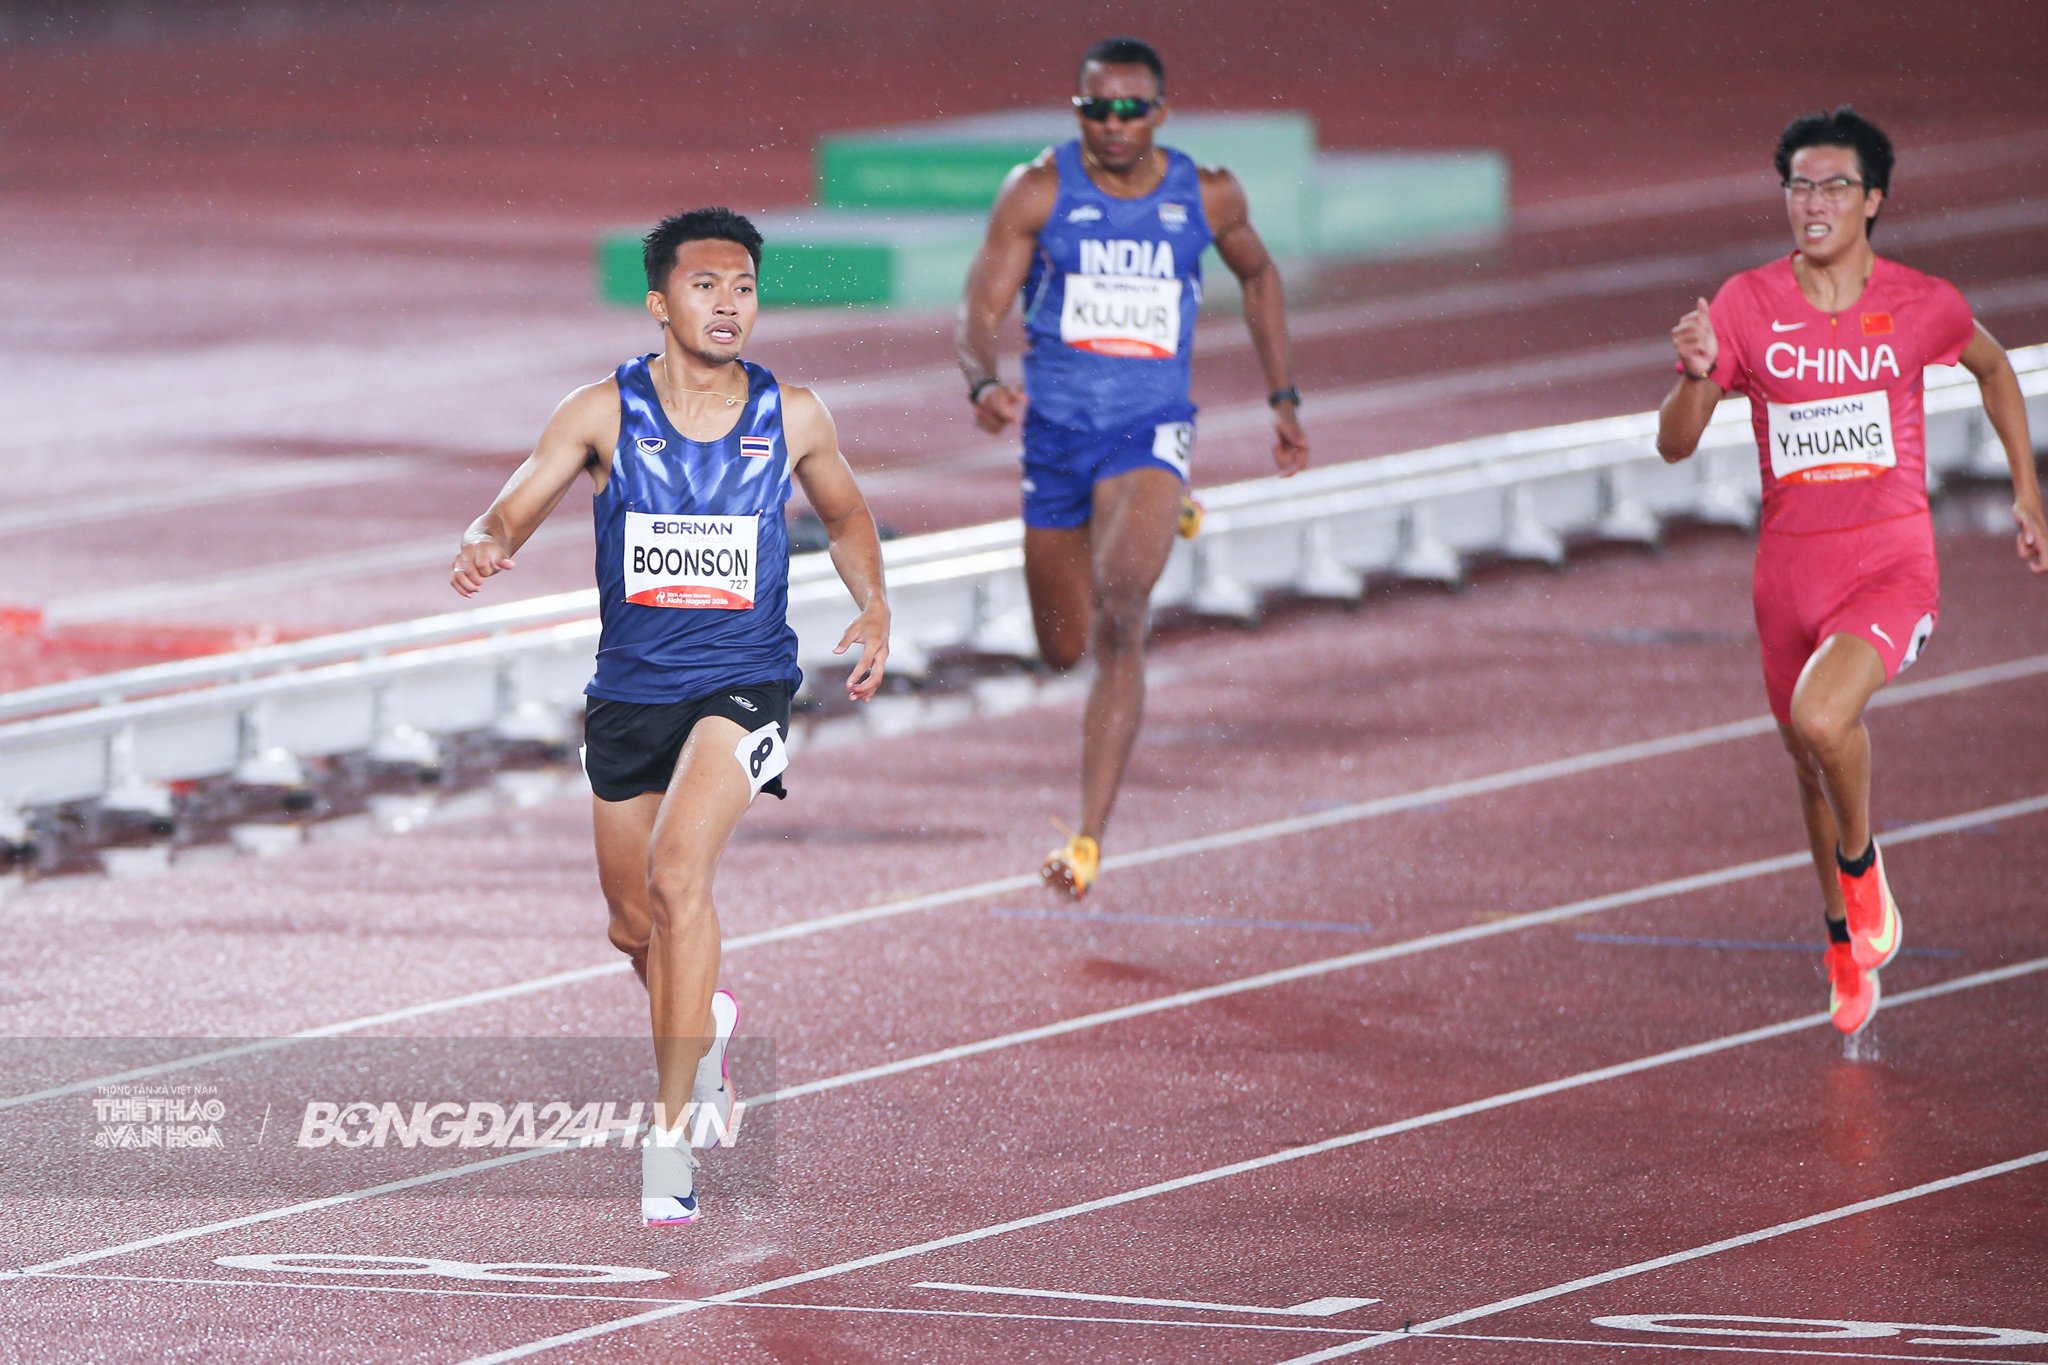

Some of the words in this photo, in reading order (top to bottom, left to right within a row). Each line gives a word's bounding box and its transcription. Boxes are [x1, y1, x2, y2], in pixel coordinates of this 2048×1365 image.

[1079, 239, 1175, 279] INDIA
[1072, 300, 1168, 329] KUJUR
[1765, 341, 1900, 384] CHINA
[1790, 402, 1864, 421] BORNAN
[1777, 423, 1884, 457] Y.HUANG
[651, 521, 733, 535] BORNAN
[633, 545, 748, 577] BOONSON
[729, 579, 748, 590] 727
[666, 597, 711, 606] Aichi-Nagoya
[750, 736, 774, 779] 8
